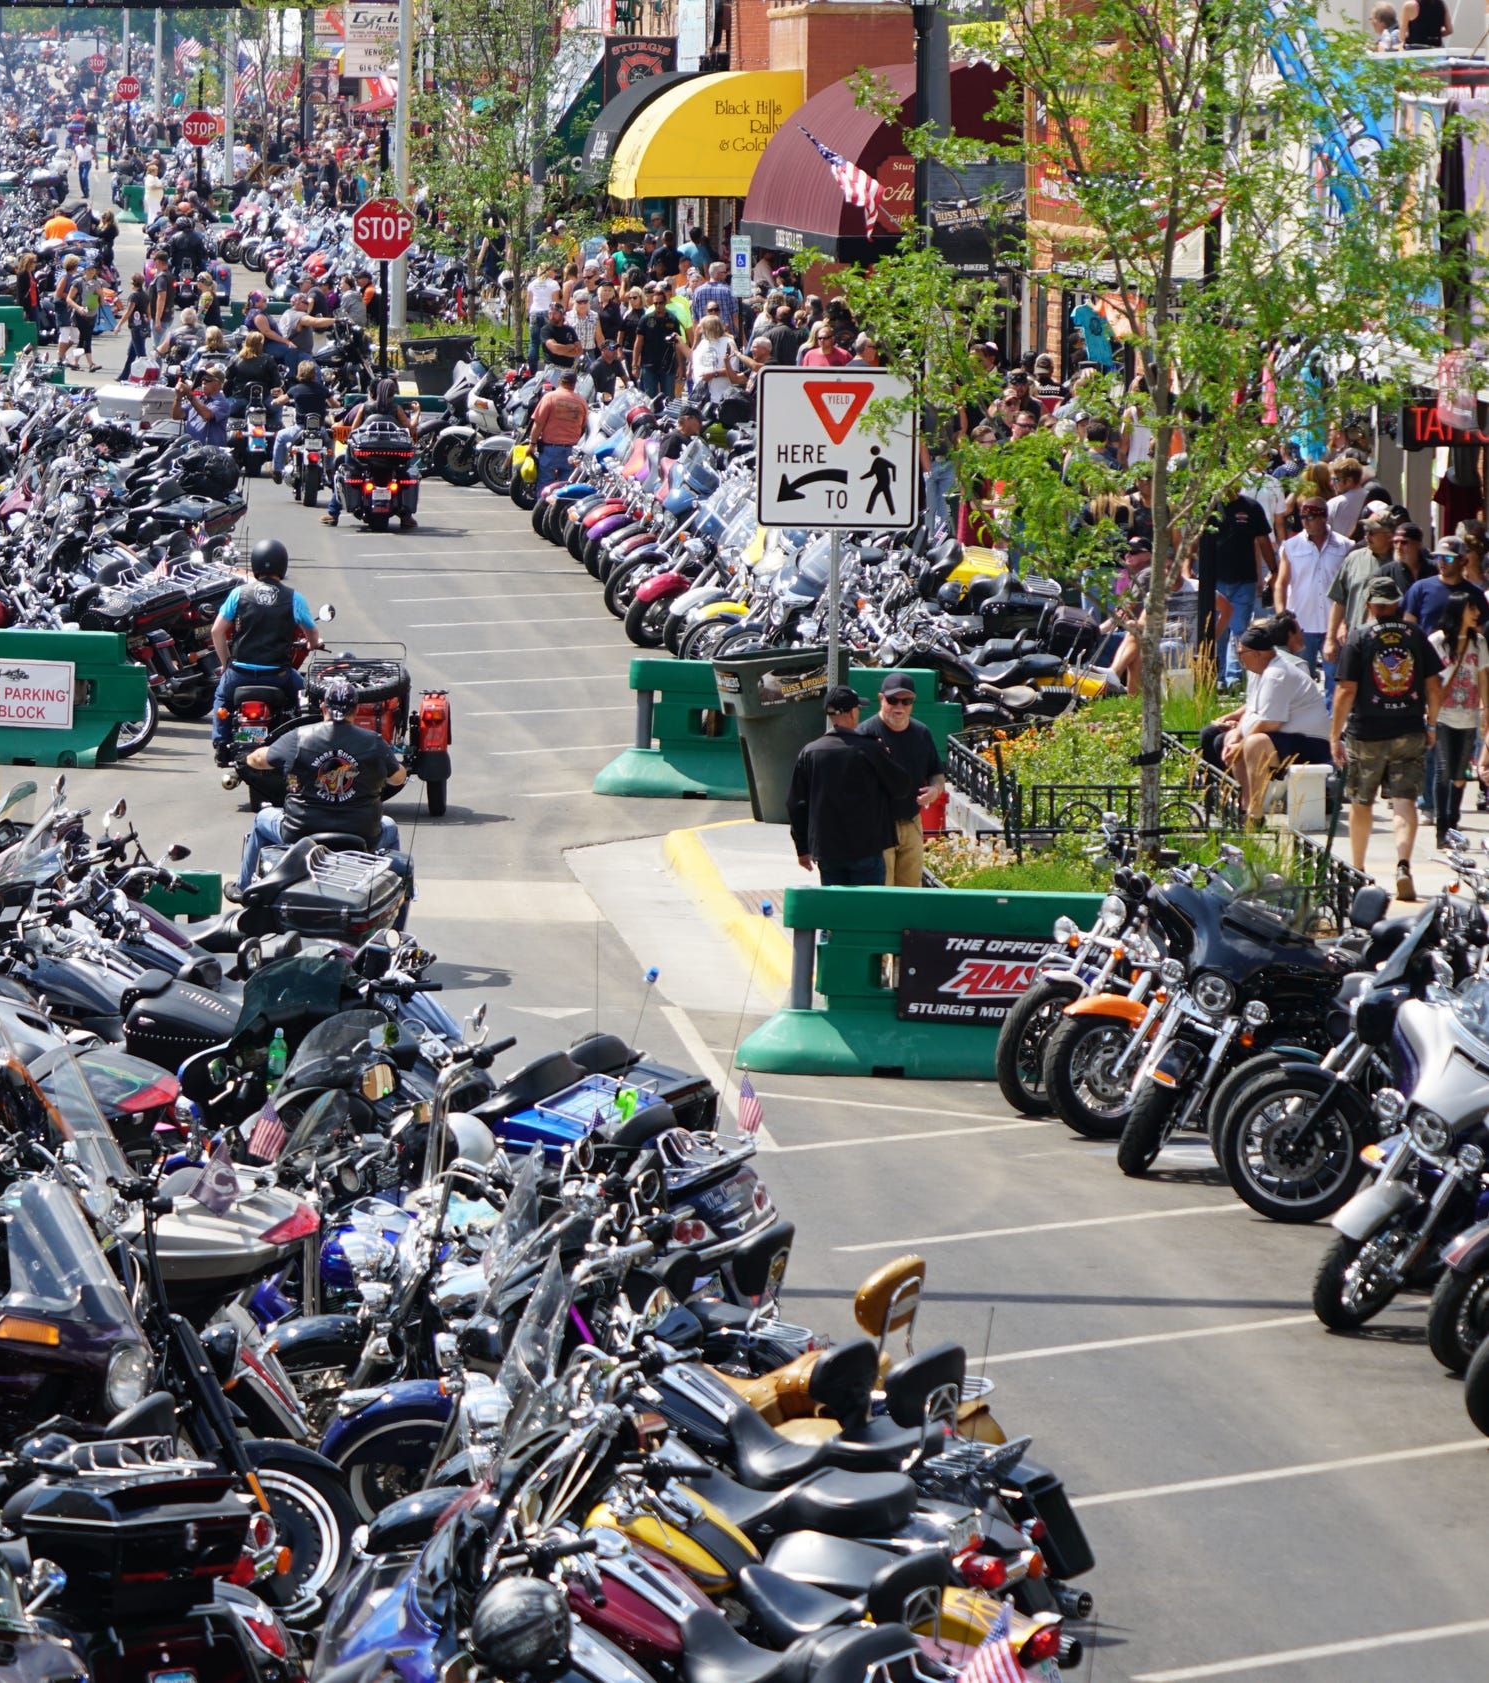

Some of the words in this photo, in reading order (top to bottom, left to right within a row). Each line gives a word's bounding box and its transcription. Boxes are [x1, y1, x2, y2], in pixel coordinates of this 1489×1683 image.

[611, 41, 672, 56] STURGIS
[118, 84, 139, 93] STOP
[715, 100, 751, 115] Black
[756, 99, 783, 116] Hills
[185, 122, 216, 135] STOP
[719, 140, 729, 151] &
[935, 209, 959, 222] RUSS
[961, 204, 993, 218] BROWN
[357, 214, 411, 240] STOP
[828, 395, 850, 405] YIELD
[777, 444, 827, 464] HERE
[826, 490, 848, 509] TO
[5, 687, 66, 703] PARKING
[781, 682, 801, 695] RUSS
[945, 937, 985, 951] THE
[985, 939, 1070, 956] OFFICIAL
[908, 1003, 975, 1017] STURGIS
[980, 1007, 1011, 1018] MOT
